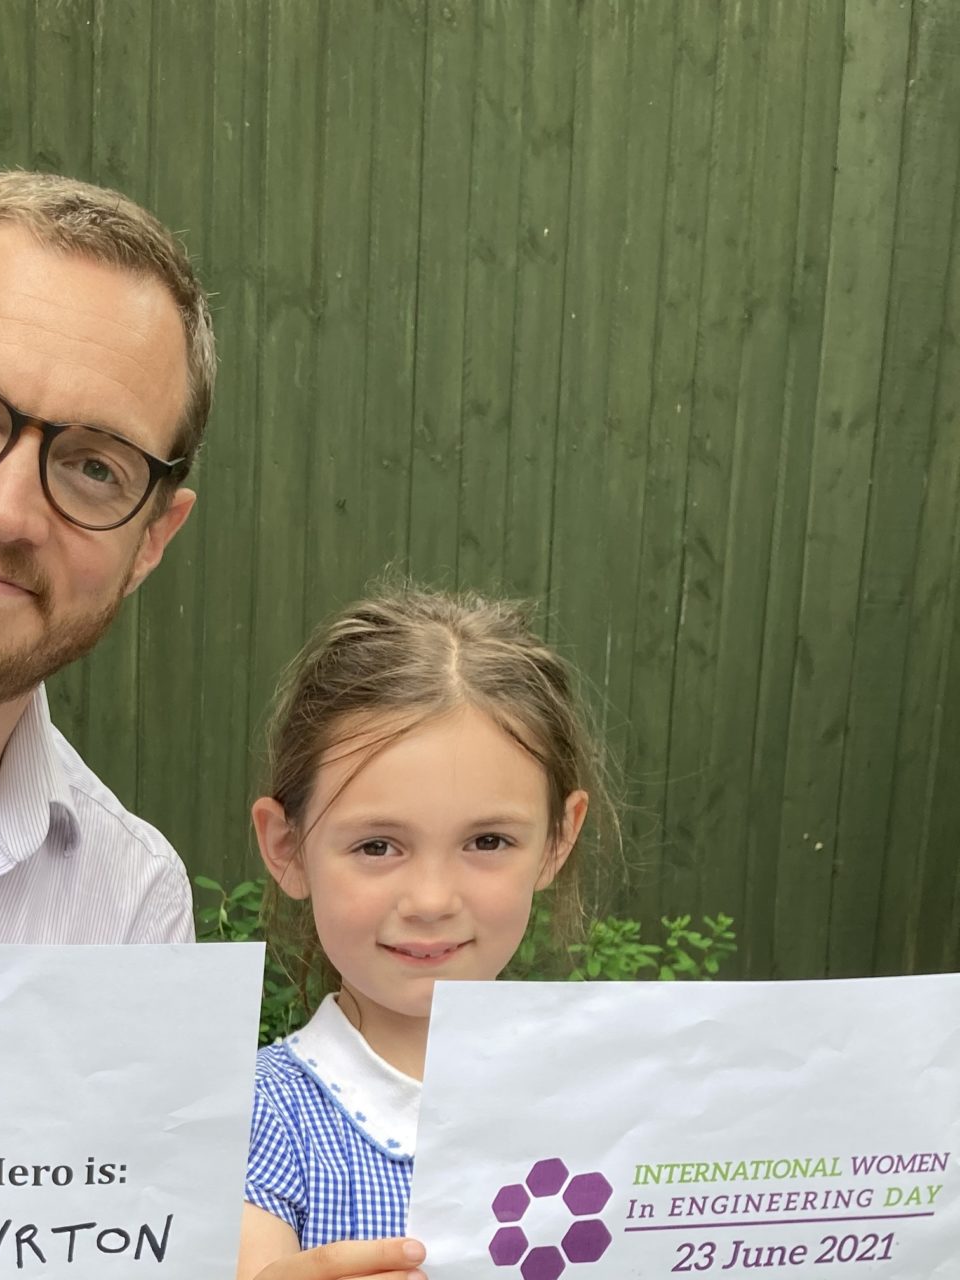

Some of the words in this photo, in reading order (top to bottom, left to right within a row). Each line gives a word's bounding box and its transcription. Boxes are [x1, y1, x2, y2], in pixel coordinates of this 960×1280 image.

[85, 1158, 126, 1184] is:
[633, 1157, 842, 1185] INTERNATIONAL
[852, 1153, 950, 1175] WOMEN
[627, 1200, 654, 1219] In
[668, 1189, 874, 1217] ENGINEERING
[884, 1185, 943, 1206] DAY
[671, 1242, 716, 1272] 23
[722, 1241, 807, 1269] June
[814, 1233, 894, 1263] 2021
